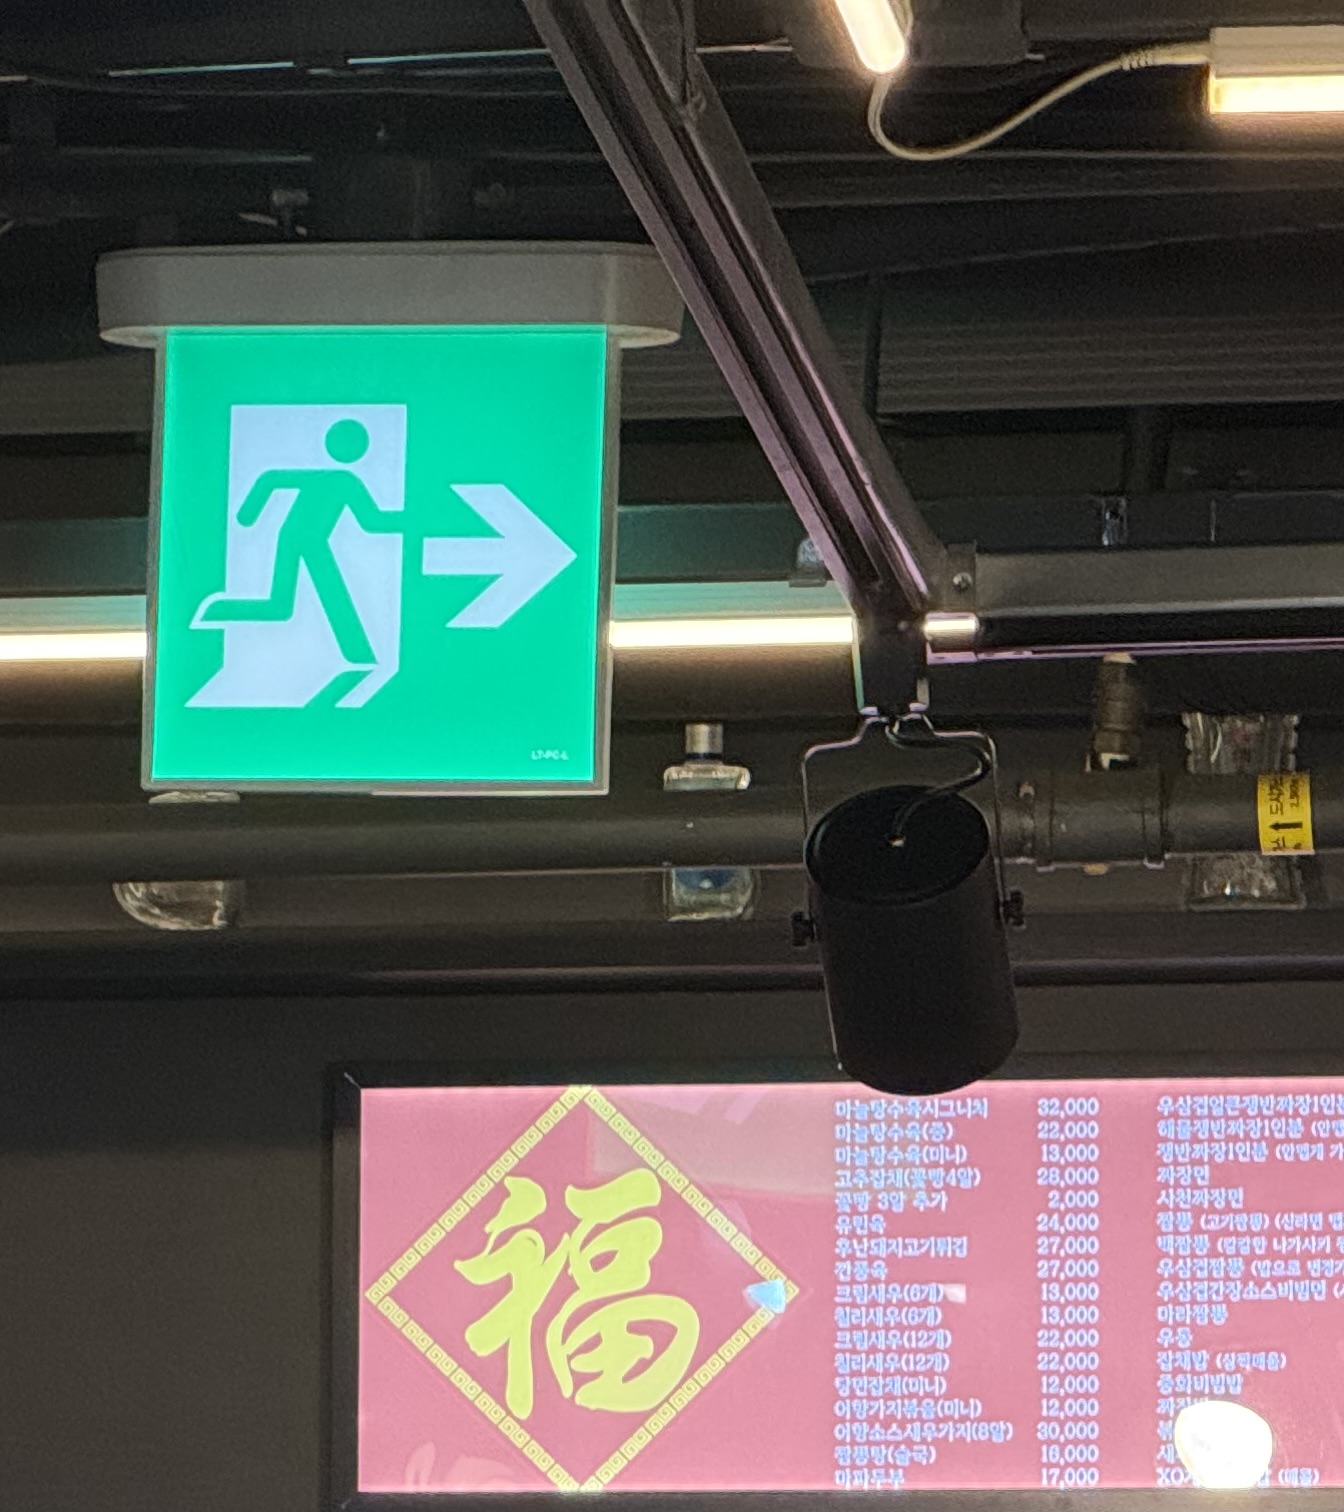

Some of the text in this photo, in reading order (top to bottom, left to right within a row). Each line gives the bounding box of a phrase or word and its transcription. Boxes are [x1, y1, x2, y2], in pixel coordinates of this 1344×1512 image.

[1037, 1098, 1099, 1120] 32,000
[1037, 1121, 1099, 1143] 22,000
[1041, 1144, 1099, 1166] 13,000
[1037, 1167, 1099, 1188] 28,000
[1048, 1190, 1099, 1212] 2,000
[1036, 1214, 1099, 1235] 24,000
[1036, 1236, 1099, 1258] 27,000
[1036, 1260, 1099, 1281] 27,000
[453, 1167, 702, 1421] 福
[1041, 1283, 1099, 1304] 13,000
[1041, 1306, 1099, 1327] 13,000
[1037, 1329, 1099, 1351] 22,000
[1037, 1352, 1099, 1374] 22,000
[1041, 1375, 1099, 1397] 12,000
[1041, 1398, 1099, 1420] 12,000
[1037, 1421, 1099, 1443] 30,000
[1041, 1445, 1099, 1466] 16,000
[1041, 1468, 1099, 1490] 17,000
